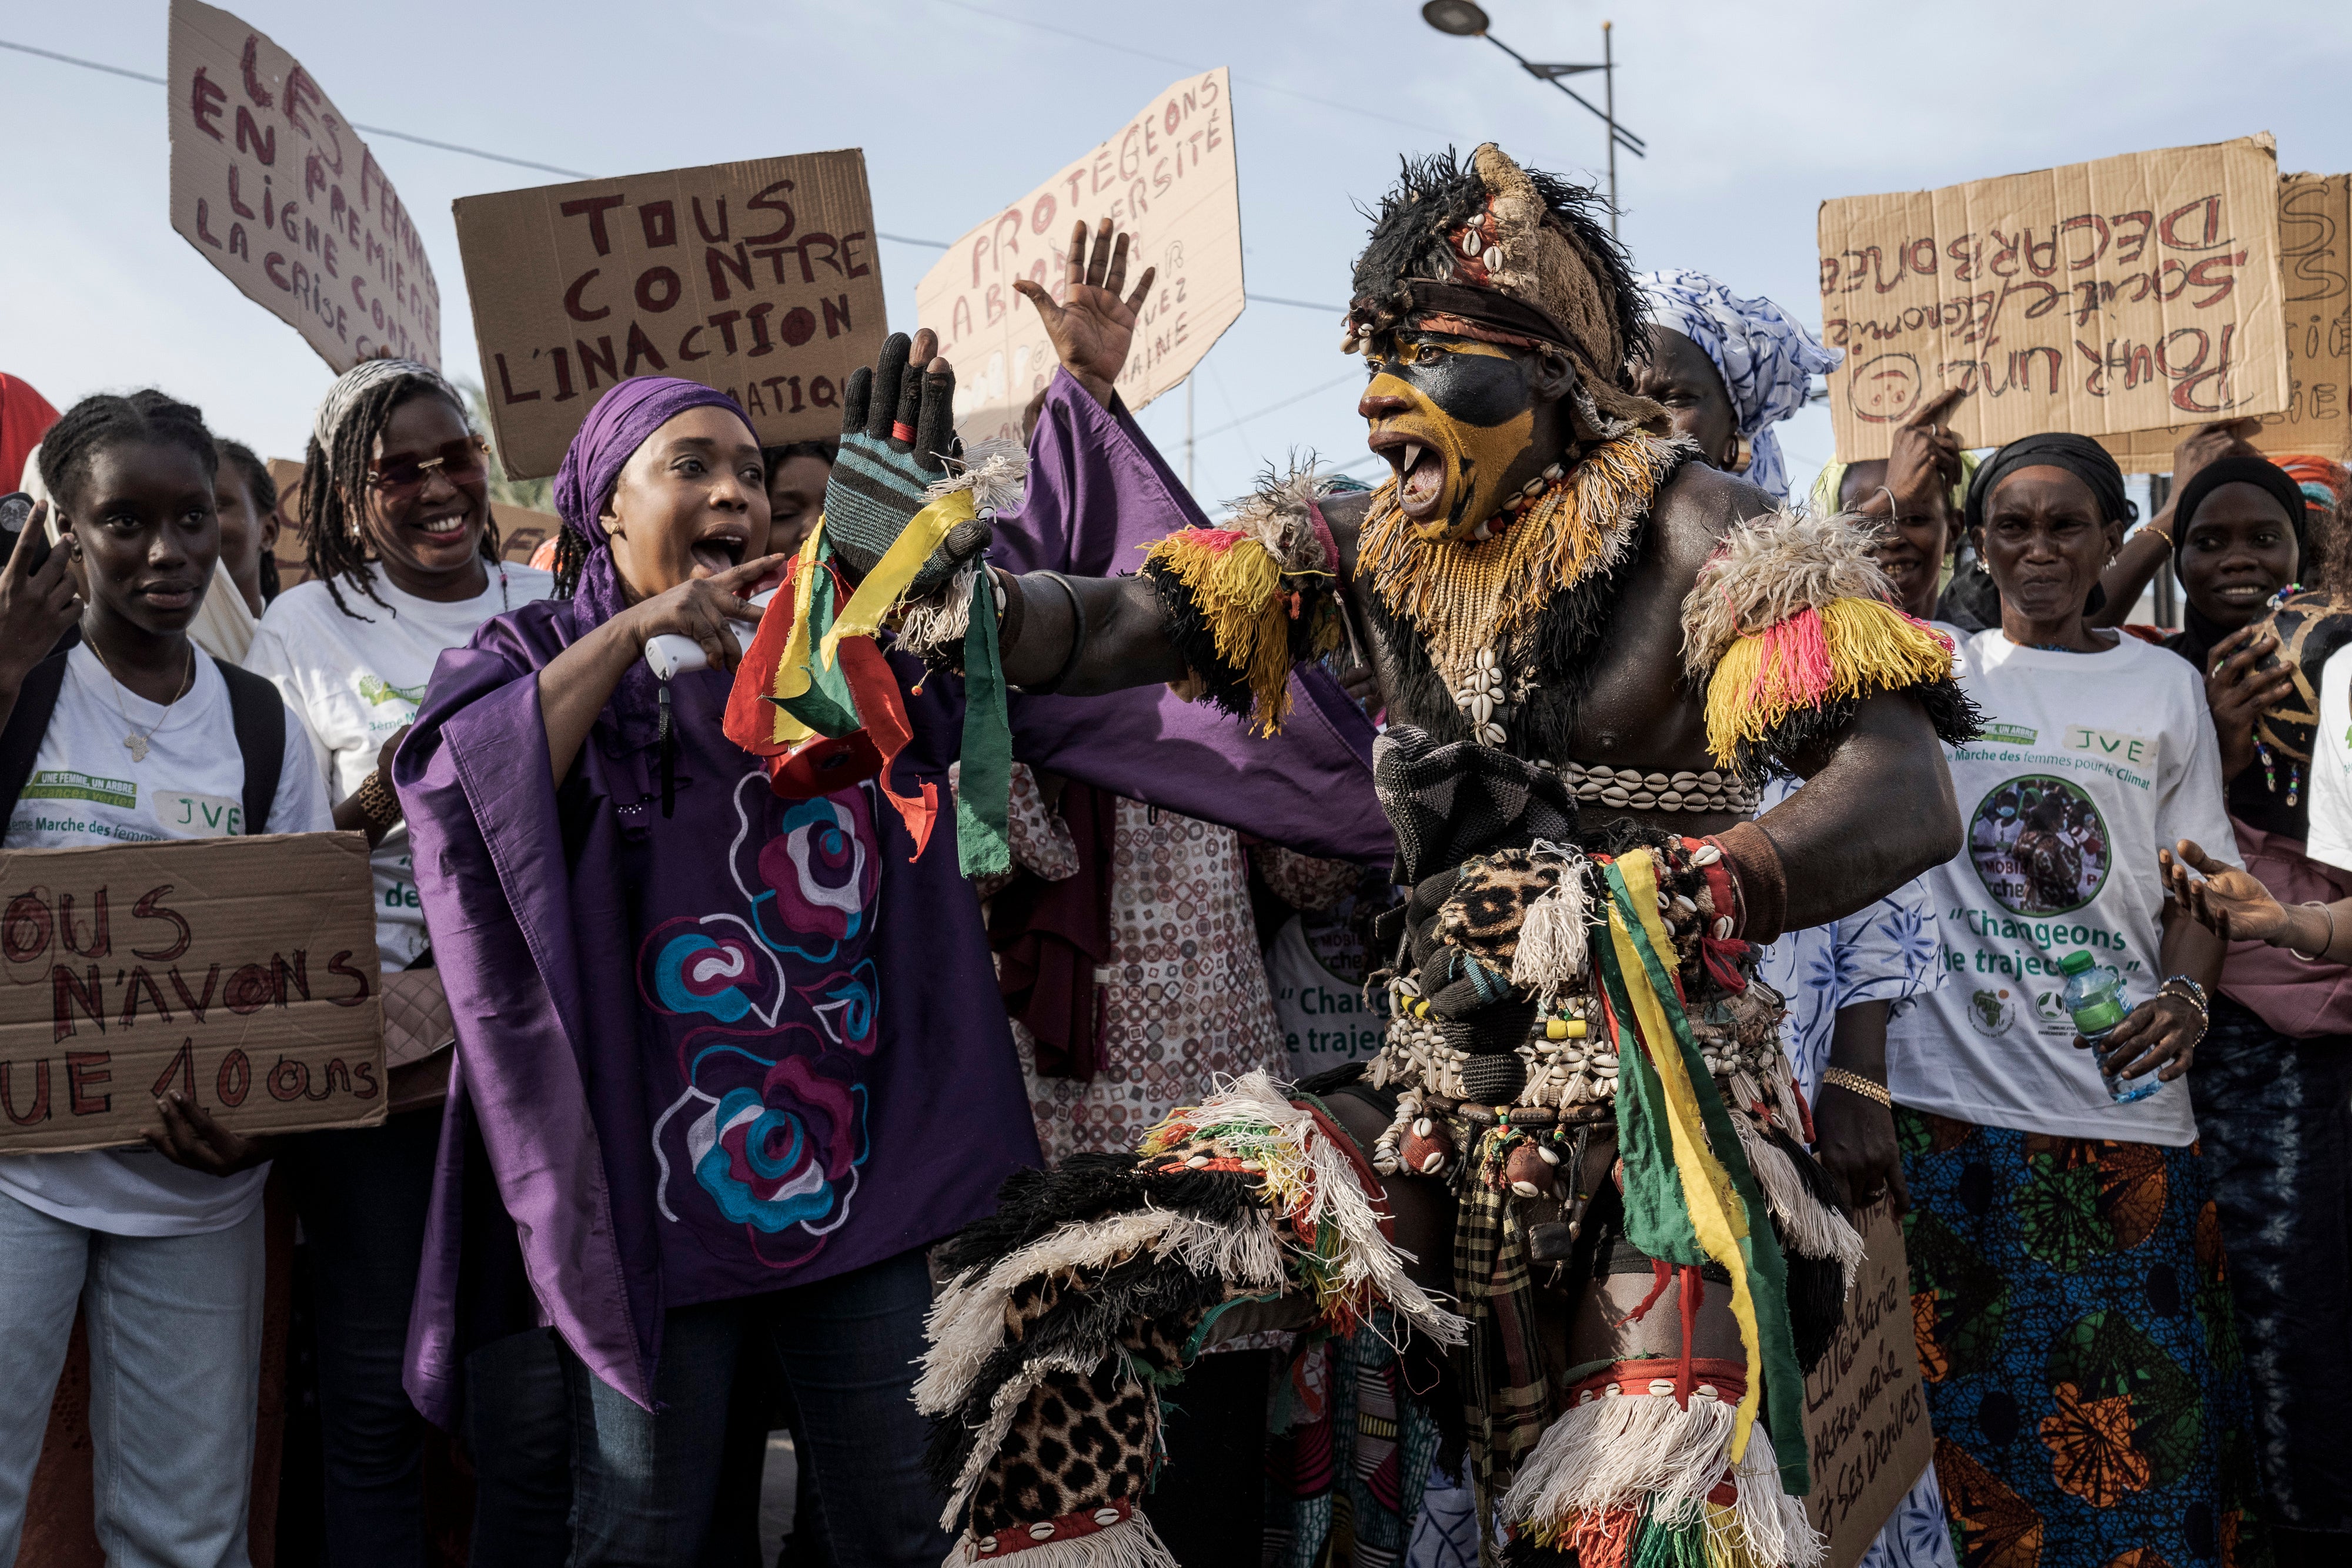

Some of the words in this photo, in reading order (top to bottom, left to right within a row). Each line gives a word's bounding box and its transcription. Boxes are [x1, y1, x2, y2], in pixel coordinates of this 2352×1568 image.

[191, 66, 276, 166] EN
[239, 34, 344, 178] LES
[196, 197, 249, 263] LA
[560, 179, 796, 257] TOUS
[563, 230, 871, 323] CONTRE
[495, 293, 851, 405] L'INACTION
[726, 375, 845, 417] ATIQ
[1955, 749, 1996, 761] Marche
[2000, 750, 2020, 761] des
[2024, 750, 2072, 767] femmes
[2075, 757, 2103, 773] pour
[2105, 760, 2115, 776] le
[2117, 768, 2151, 791] Climat
[2076, 730, 2144, 763] JVE
[41, 773, 59, 784] UNE
[92, 779, 105, 788] UN
[106, 780, 133, 794] ARBRE
[178, 798, 241, 836] JVE
[36, 817, 85, 832] Marche
[89, 821, 111, 836] des
[2, 885, 192, 964] OUS
[385, 881, 420, 908] de
[52, 948, 369, 1044] N'AVONS
[1, 1050, 112, 1126] UE
[151, 1037, 251, 1114] 10
